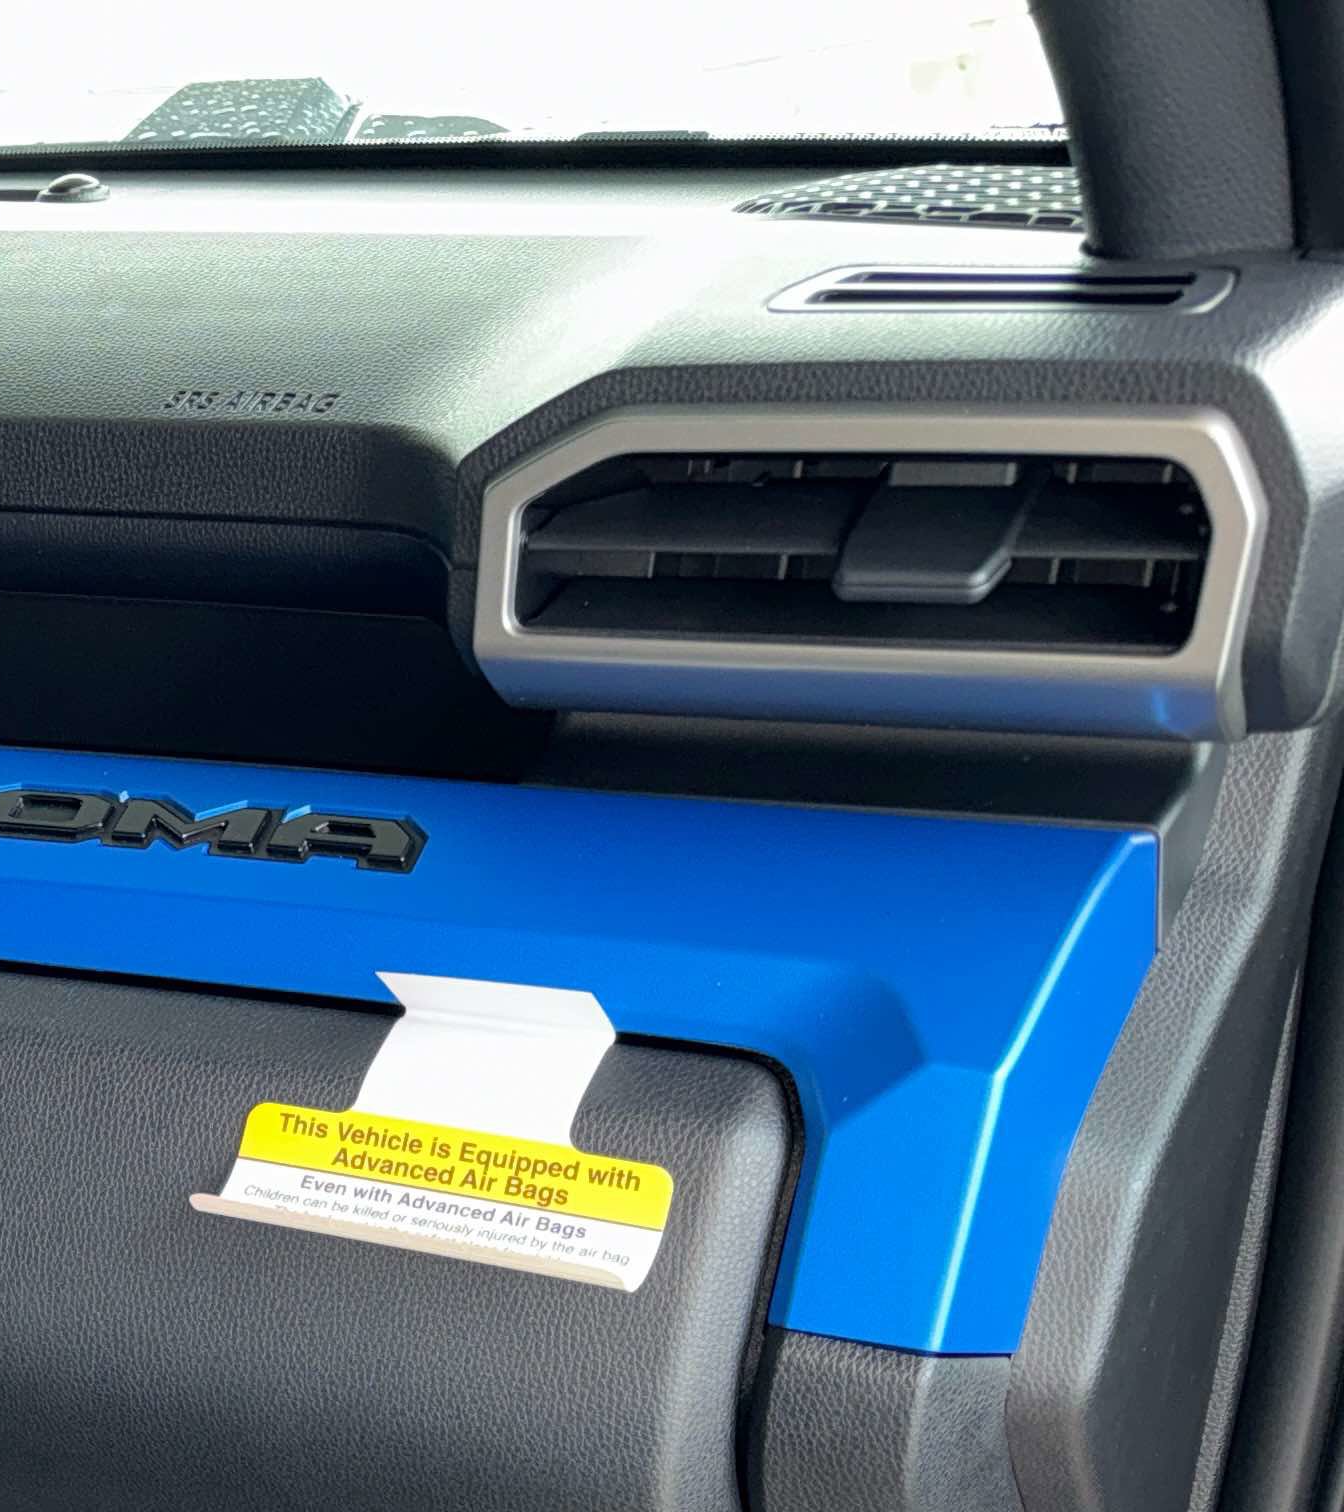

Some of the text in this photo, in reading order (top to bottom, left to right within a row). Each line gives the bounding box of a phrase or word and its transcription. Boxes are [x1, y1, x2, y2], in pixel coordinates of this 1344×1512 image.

[163, 390, 341, 414] SRS AIRBAG
[280, 1113, 641, 1191] This Vehicle is Equipped with
[331, 1147, 569, 1207] Advanced Air Bags
[242, 1184, 300, 1205] Children
[303, 1197, 328, 1210] can
[331, 1199, 349, 1213] be
[352, 1205, 390, 1222] killed
[392, 1213, 408, 1224] or
[409, 1216, 475, 1238] seriously
[477, 1227, 528, 1246] injured
[530, 1234, 548, 1251] by
[552, 1241, 575, 1255] the
[579, 1247, 599, 1258] air
[300, 1174, 587, 1240] Even with Advanced Air Bags
